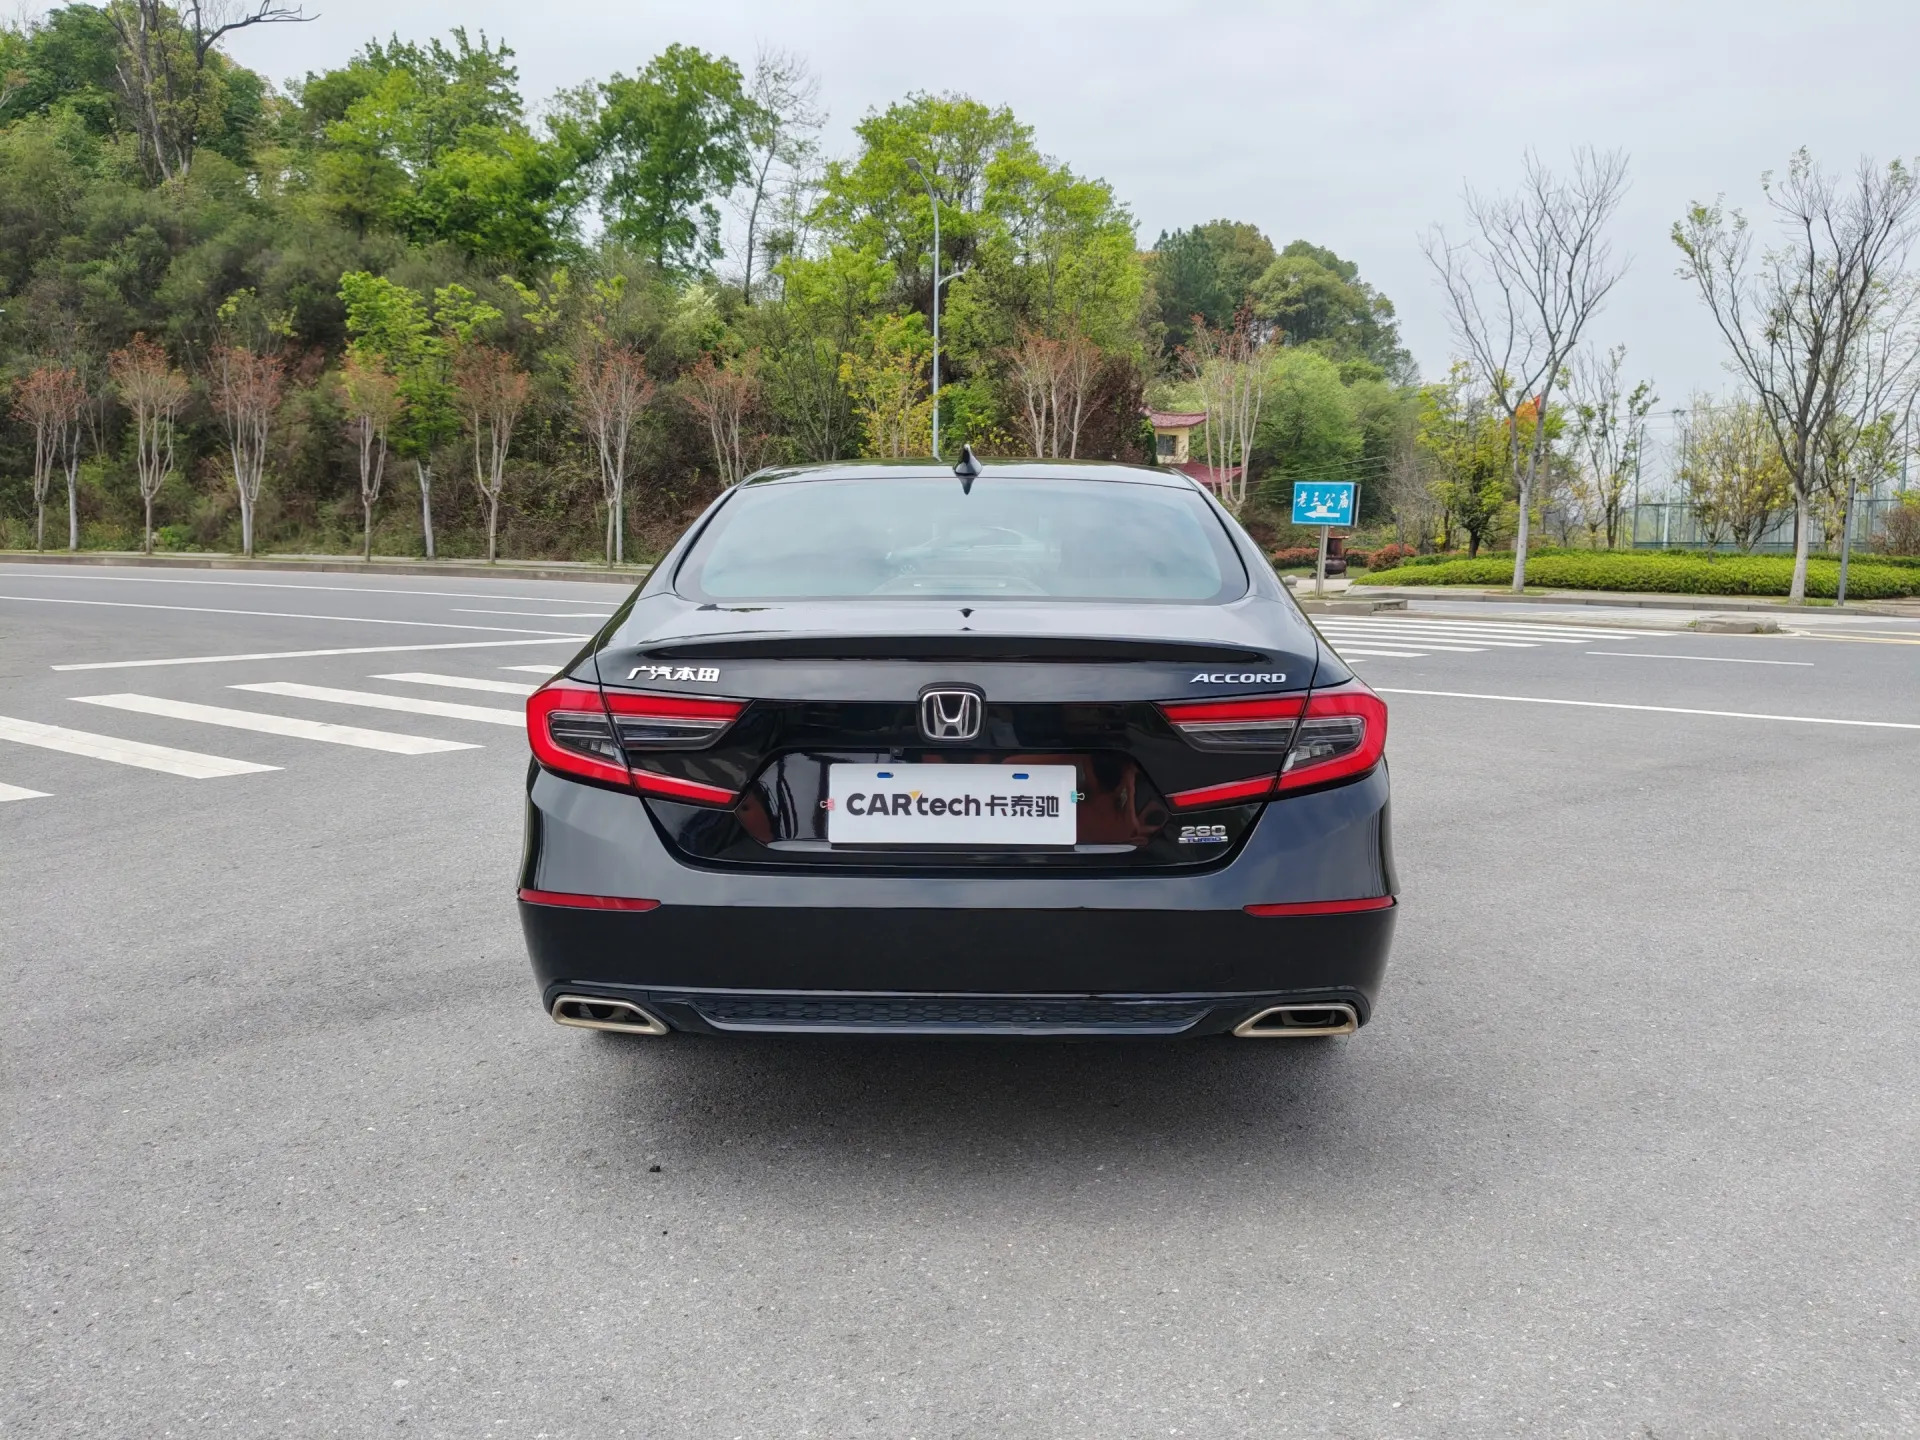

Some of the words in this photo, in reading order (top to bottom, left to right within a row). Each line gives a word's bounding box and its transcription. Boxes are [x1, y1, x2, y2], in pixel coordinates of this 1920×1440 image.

[627, 665, 720, 682] 广汽本田
[1189, 673, 1287, 683] ACCORD
[846, 791, 981, 817] CARtech
[984, 795, 1060, 818] 卡泰驰
[1181, 825, 1226, 837] 260
